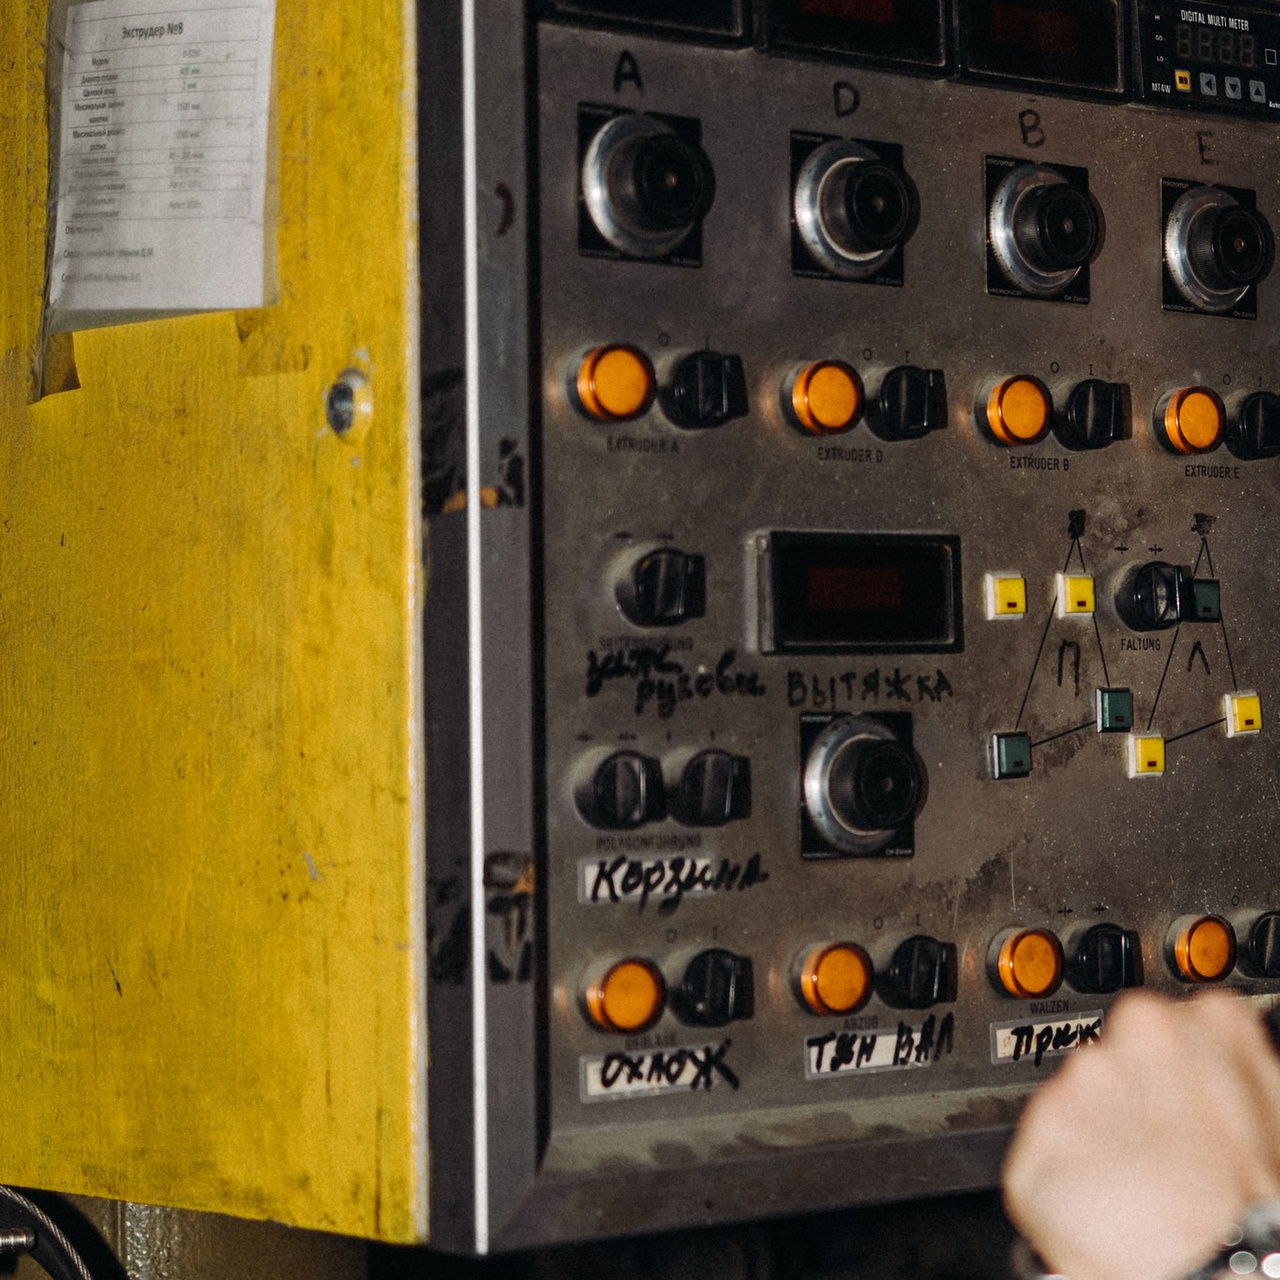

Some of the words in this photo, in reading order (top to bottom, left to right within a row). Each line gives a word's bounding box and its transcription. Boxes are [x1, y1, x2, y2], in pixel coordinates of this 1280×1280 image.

[1180, 9, 1206, 26] DIGITAL
[1207, 14, 1228, 28] MULTI
[1228, 18, 1250, 32] METER
[121, 26, 165, 40] Экструдер
[167, 22, 184, 36] №8
[612, 48, 644, 98] A
[1151, 82, 1171, 95] MT4W
[832, 80, 861, 119] D
[1018, 108, 1046, 149] B
[816, 446, 873, 463] EXTRUDER
[874, 449, 884, 464] D
[1009, 455, 1058, 473] EXTRUDER
[1061, 458, 1071, 473] B
[1184, 464, 1231, 480] EXTRUDER
[1232, 467, 1241, 481] E
[1120, 637, 1162, 652] FALTUNG
[786, 668, 956, 709] ВЫТЯЖКА
[1029, 999, 1070, 1016] WALZEN
[843, 1014, 880, 1031] ABZUG
